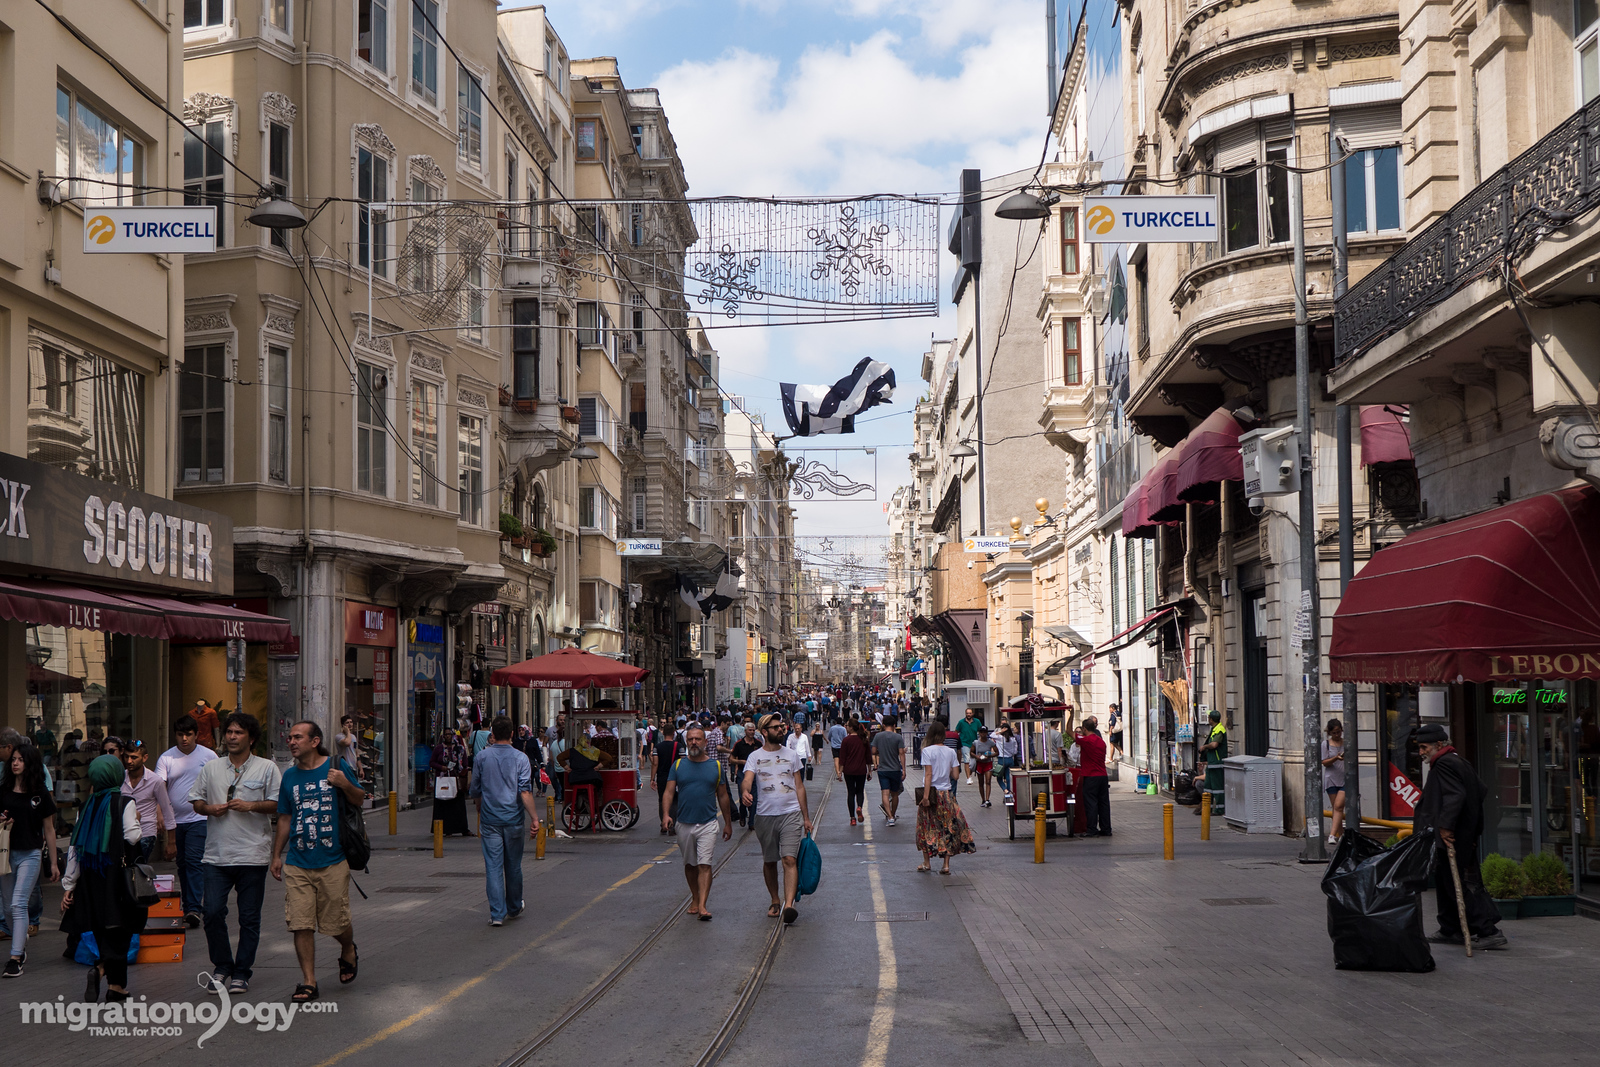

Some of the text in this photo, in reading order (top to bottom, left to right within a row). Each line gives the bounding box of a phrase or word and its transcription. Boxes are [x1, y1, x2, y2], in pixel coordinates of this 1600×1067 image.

[1122, 211, 1216, 227] TURKCELL
[122, 222, 214, 237] TURKCELL
[83, 494, 214, 583] SCOOTER
[1489, 653, 1600, 676] LEBON
[1493, 688, 1527, 704] Cafe
[1389, 775, 1420, 809] SAL
